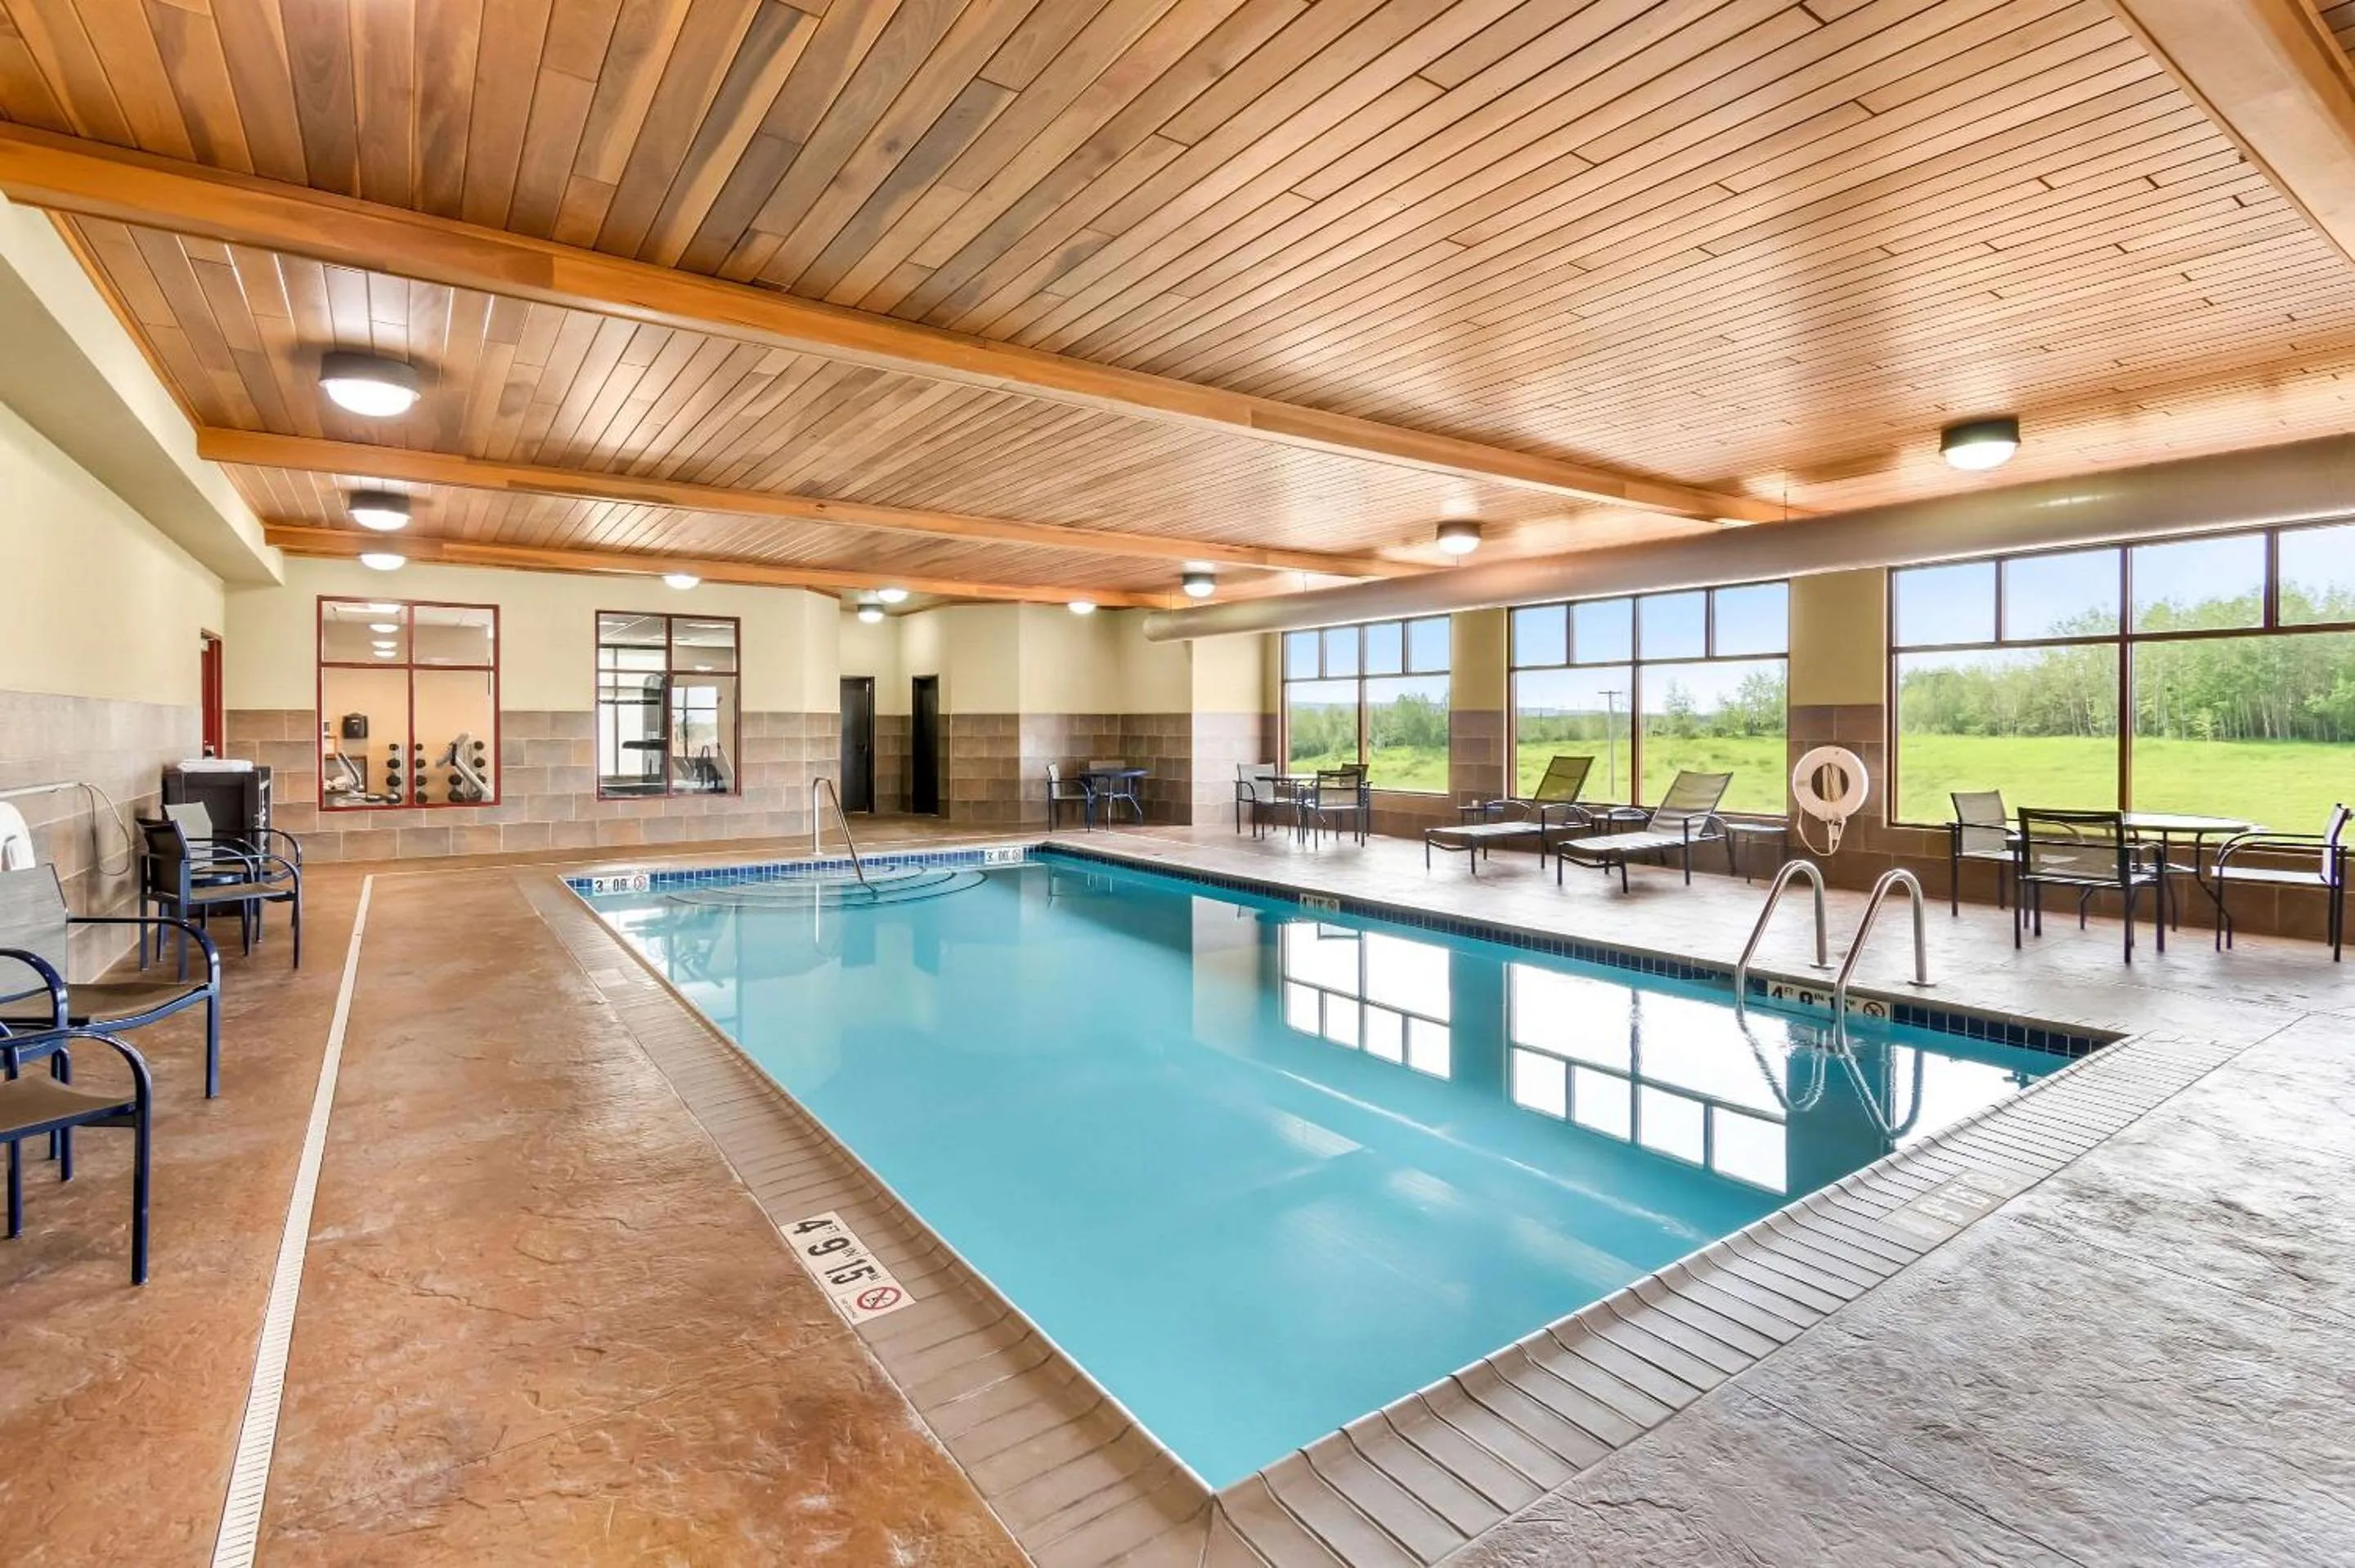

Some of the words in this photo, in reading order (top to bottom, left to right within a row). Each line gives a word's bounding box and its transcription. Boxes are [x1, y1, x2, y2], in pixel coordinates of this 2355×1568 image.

[594, 880, 603, 893] 3
[793, 1220, 833, 1235] 4
[807, 1236, 850, 1257] 9
